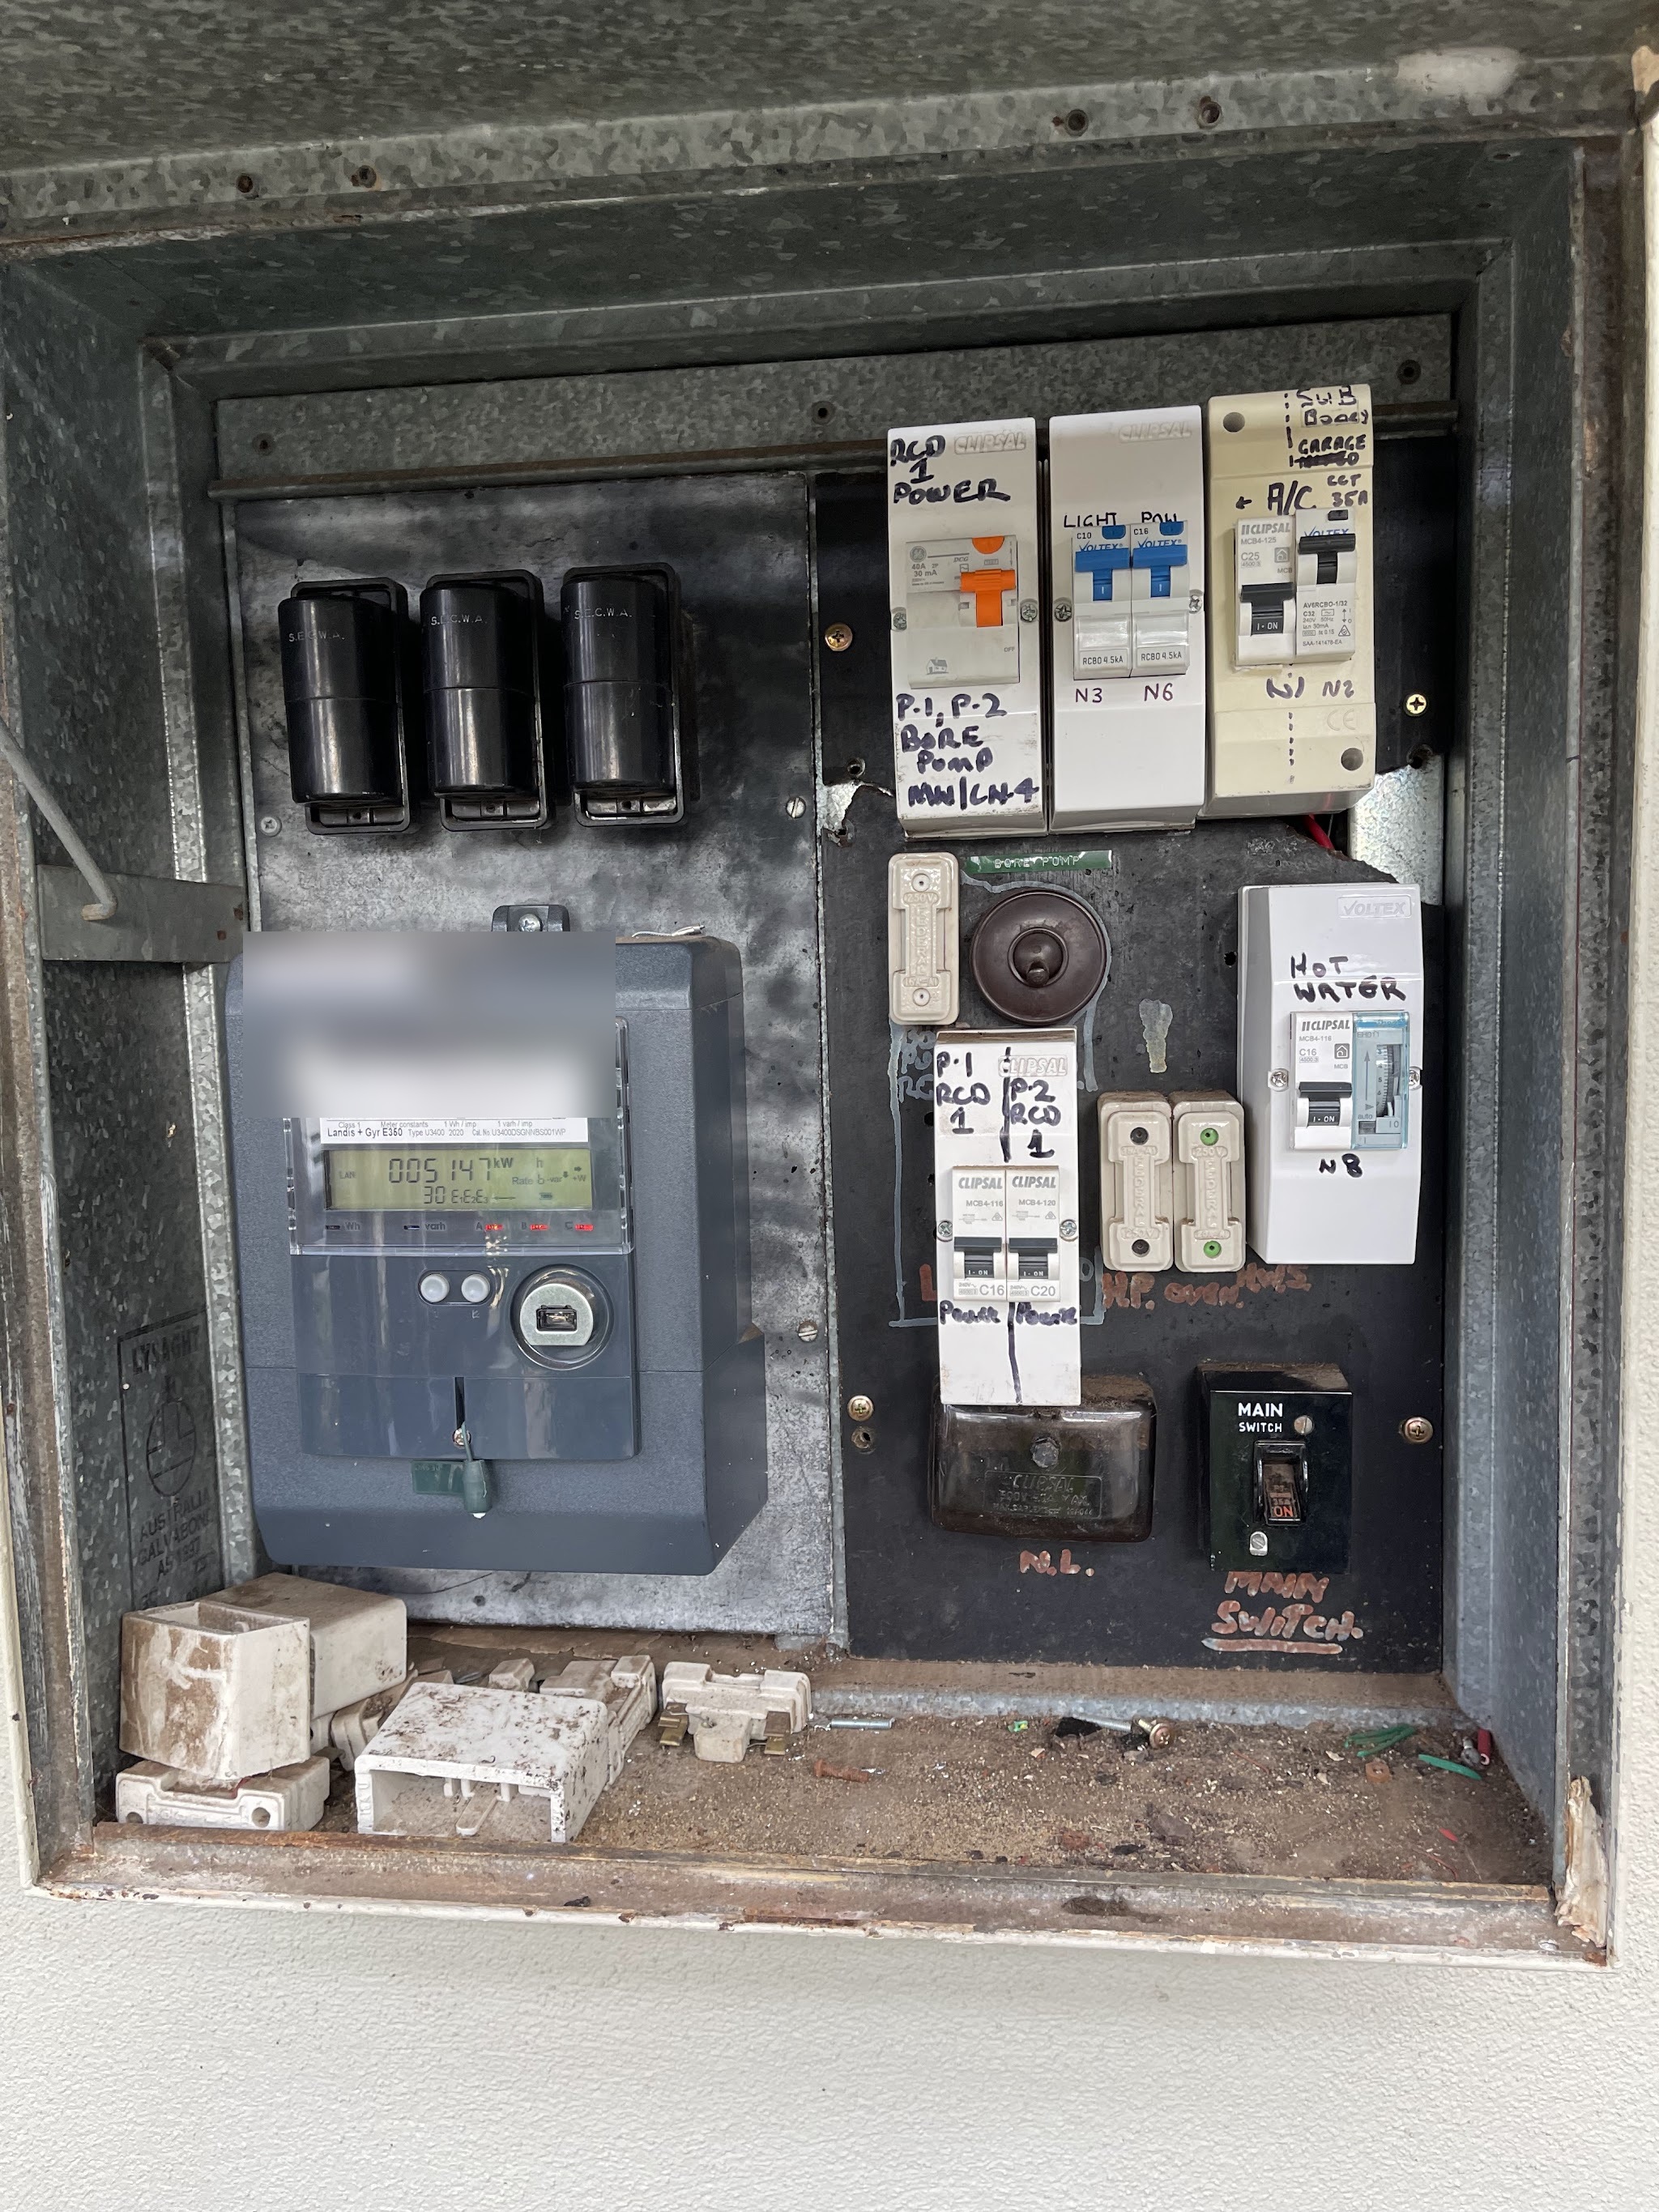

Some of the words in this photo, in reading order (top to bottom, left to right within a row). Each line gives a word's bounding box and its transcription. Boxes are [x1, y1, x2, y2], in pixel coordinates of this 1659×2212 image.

[954, 432, 1026, 454] CLIPSAL
[1299, 434, 1367, 454] GARAGE
[890, 434, 945, 467] RCD
[893, 478, 1011, 505] POWER
[1241, 537, 1277, 545] MCB4-125
[1241, 552, 1260, 560] C25
[1267, 622, 1278, 631] ON
[1075, 688, 1102, 703] N3
[1144, 683, 1174, 701] N6
[901, 723, 984, 752] BORE
[1343, 898, 1408, 916] VOLTEX
[1290, 952, 1349, 978] HOT
[1294, 975, 1406, 1003] WATER
[936, 1082, 991, 1106] RCD
[327, 1127, 355, 1137] Landis
[365, 1128, 381, 1139] Gyr
[408, 1129, 423, 1137] Type
[494, 1157, 514, 1168] kW
[512, 1176, 533, 1185] Rate
[958, 1177, 1004, 1190] CLIPSAL
[1012, 1175, 1056, 1188] CLIPSAL
[1018, 1199, 1056, 1207] MCB4-120
[424, 1221, 446, 1230] varh
[979, 1285, 1005, 1296] C16
[1030, 1285, 1056, 1297] C20
[1238, 1403, 1283, 1417] MAIN
[1239, 1421, 1282, 1433] SWITCH
[1273, 1507, 1293, 1517] ON
